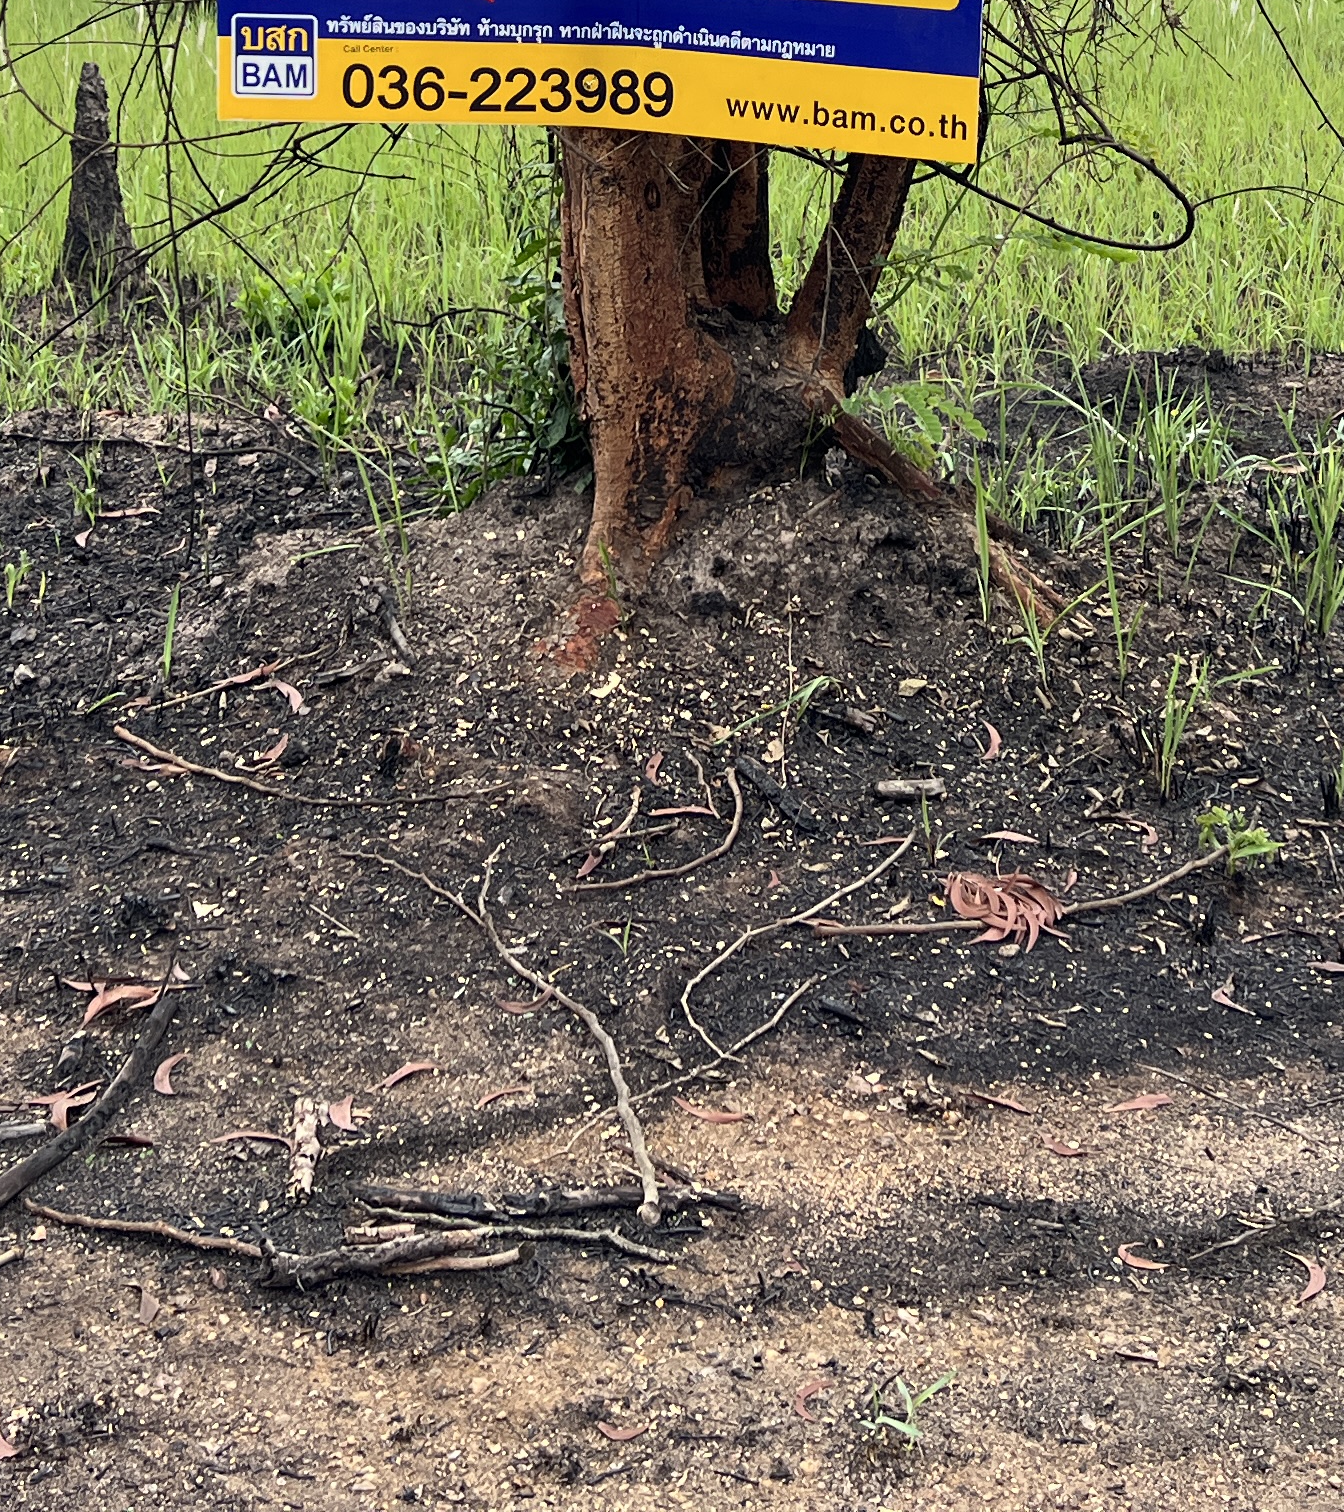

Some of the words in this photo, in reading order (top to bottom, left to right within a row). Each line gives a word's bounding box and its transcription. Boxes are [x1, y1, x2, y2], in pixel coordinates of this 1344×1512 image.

[240, 24, 308, 52] บสก
[326, 14, 471, 37] ทรัพย์สินของบริษัท
[478, 19, 553, 44] ห้ามบุกรุก
[559, 21, 836, 59] หากฝ่าฝืนจะถูกดำเนินคดีตามกฎหมาย
[343, 44, 361, 53] Call
[242, 62, 307, 89] BAM
[342, 63, 674, 118] 036-223989
[726, 97, 968, 141] www.bam.co.th
